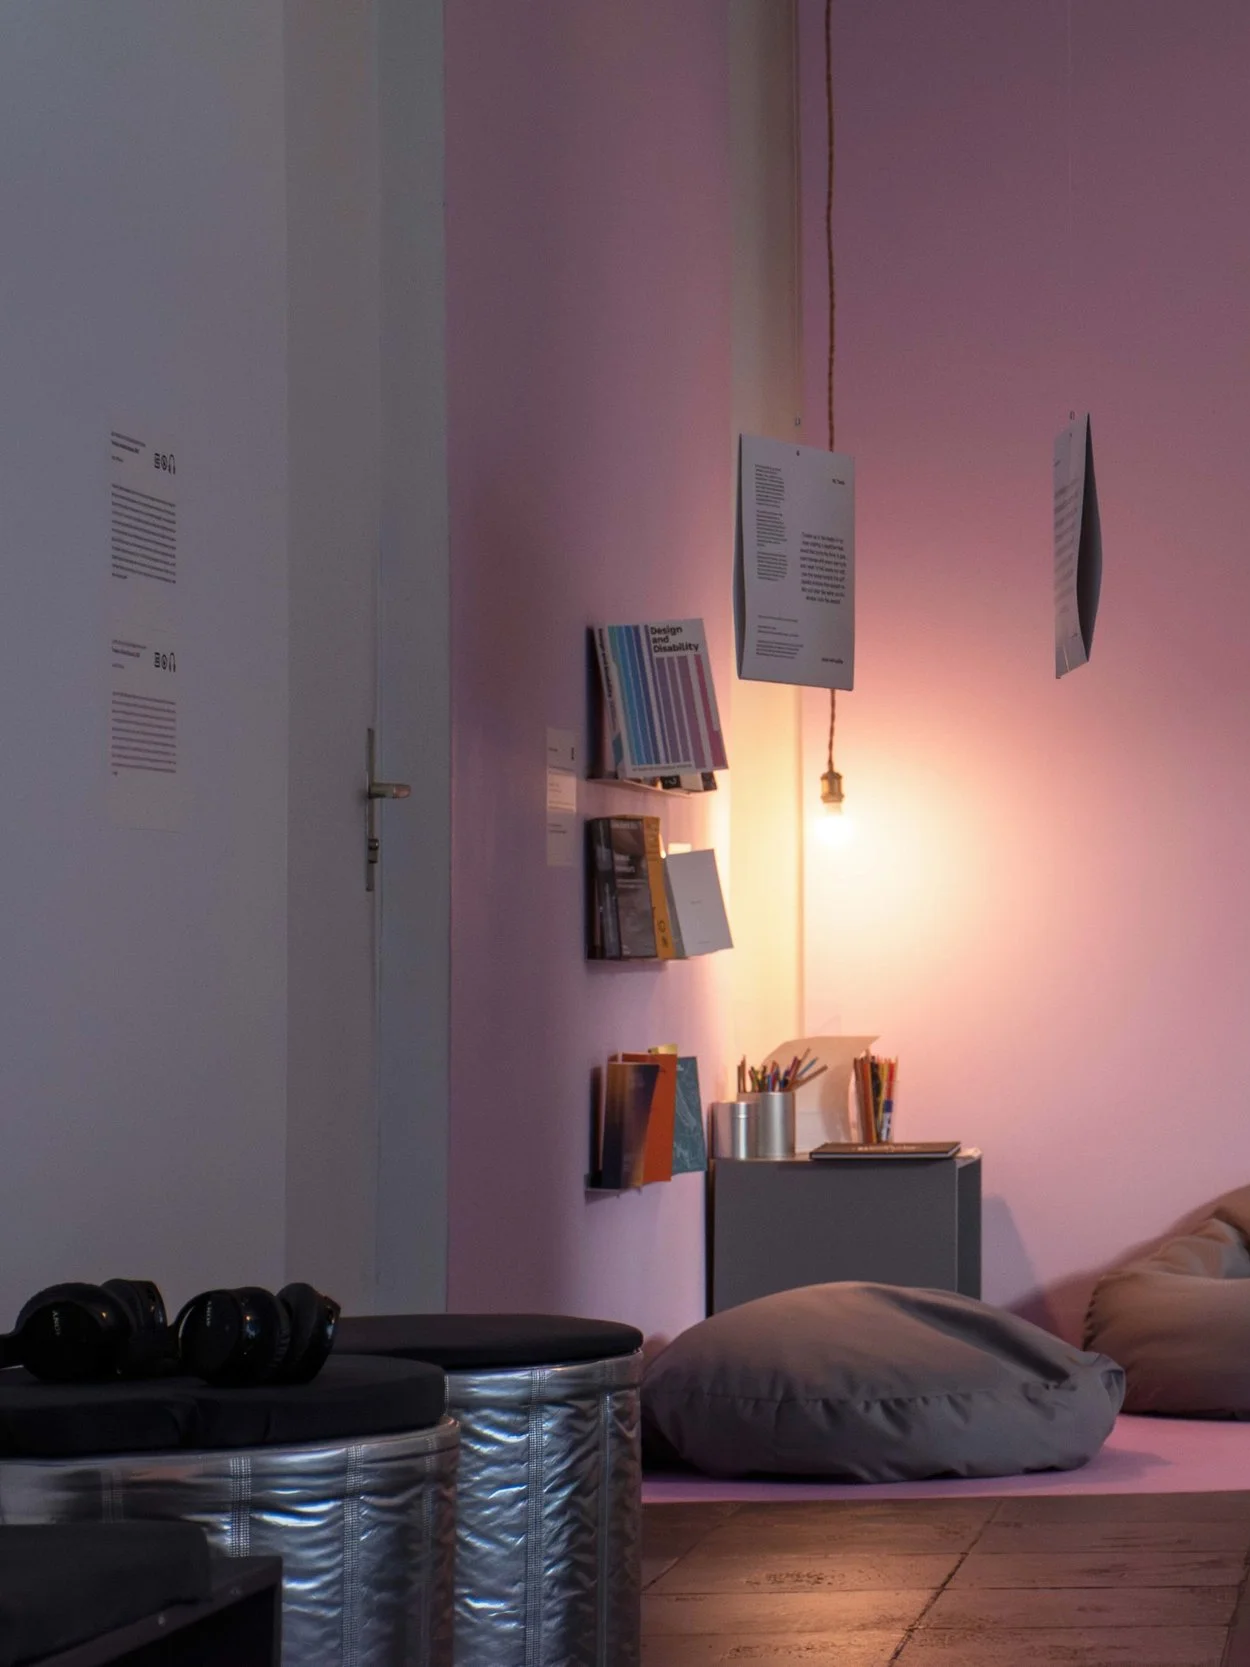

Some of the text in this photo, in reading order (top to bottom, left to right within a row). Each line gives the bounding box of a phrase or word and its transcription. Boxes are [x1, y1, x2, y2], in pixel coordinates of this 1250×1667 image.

[650, 625, 683, 636] Design
[652, 635, 669, 644] and
[653, 642, 699, 653] Disability
